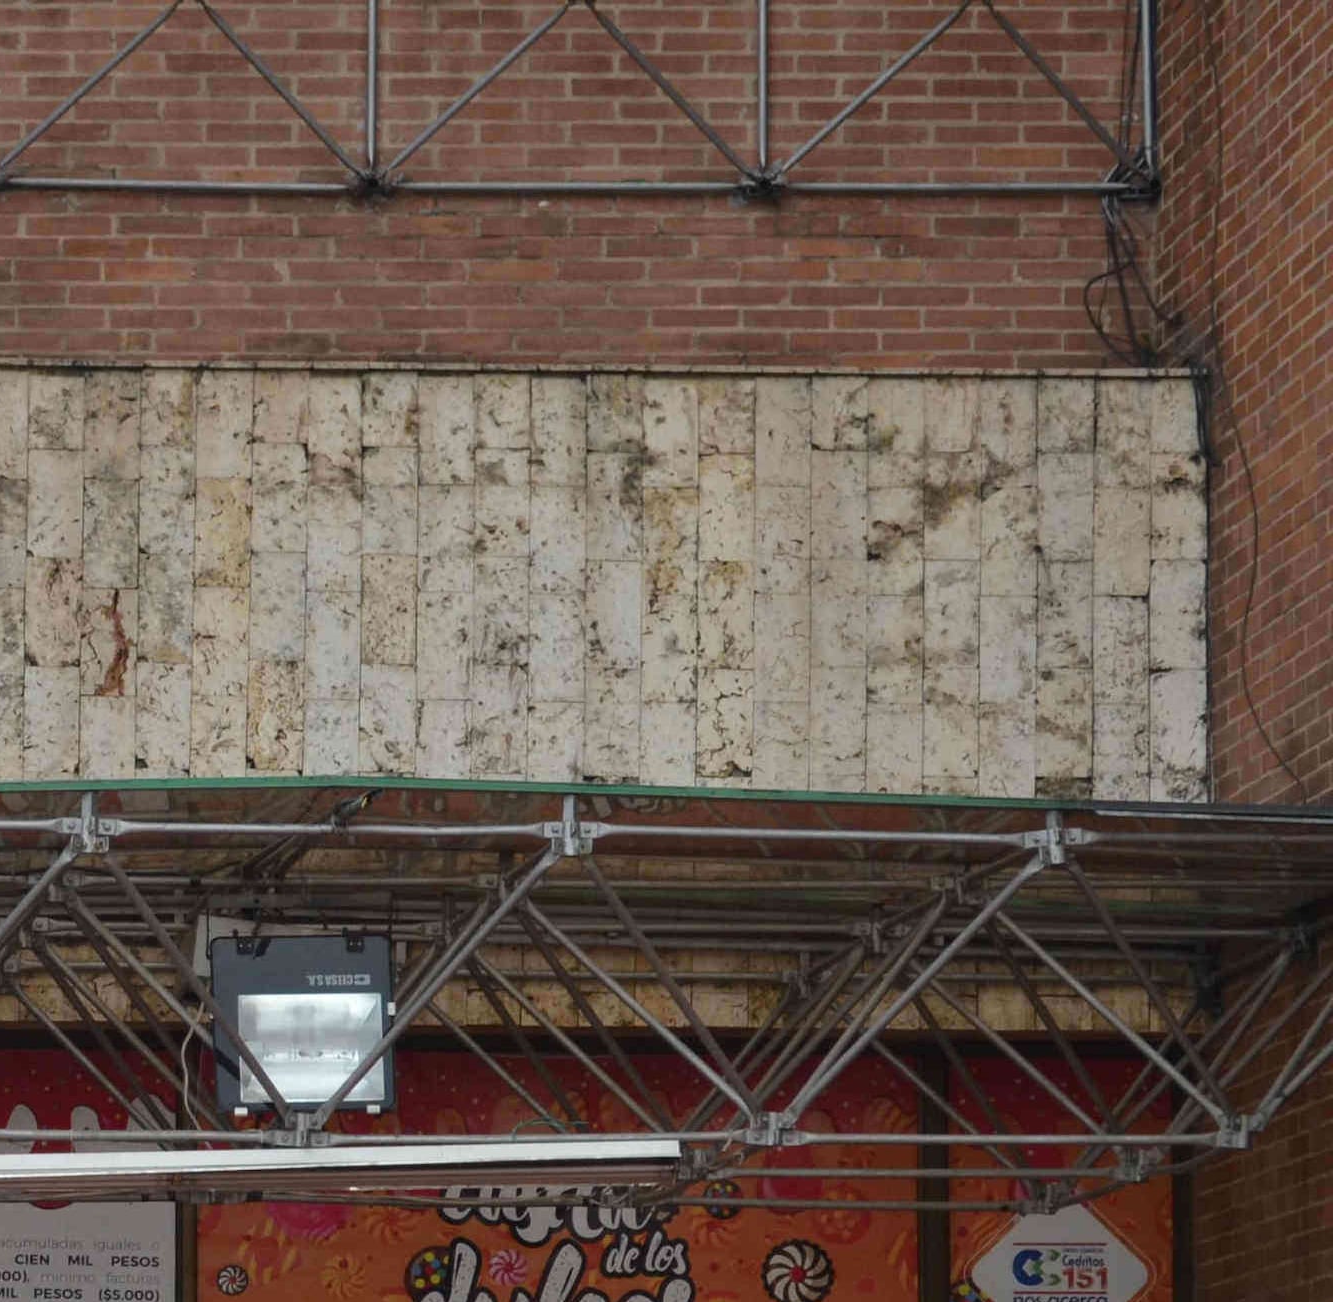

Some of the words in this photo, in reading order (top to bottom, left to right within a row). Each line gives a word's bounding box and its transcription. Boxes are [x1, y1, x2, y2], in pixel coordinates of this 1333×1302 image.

[14, 1254, 50, 1266] CIEN
[68, 1255, 93, 1266] MIL
[111, 1256, 160, 1267] PESOS
[605, 1233, 635, 1274] de
[644, 1230, 687, 1275] los
[1063, 1267, 1108, 1289] 151
[34, 1288, 83, 1300] PESOS
[98, 1289, 160, 1302] ($5.000)
